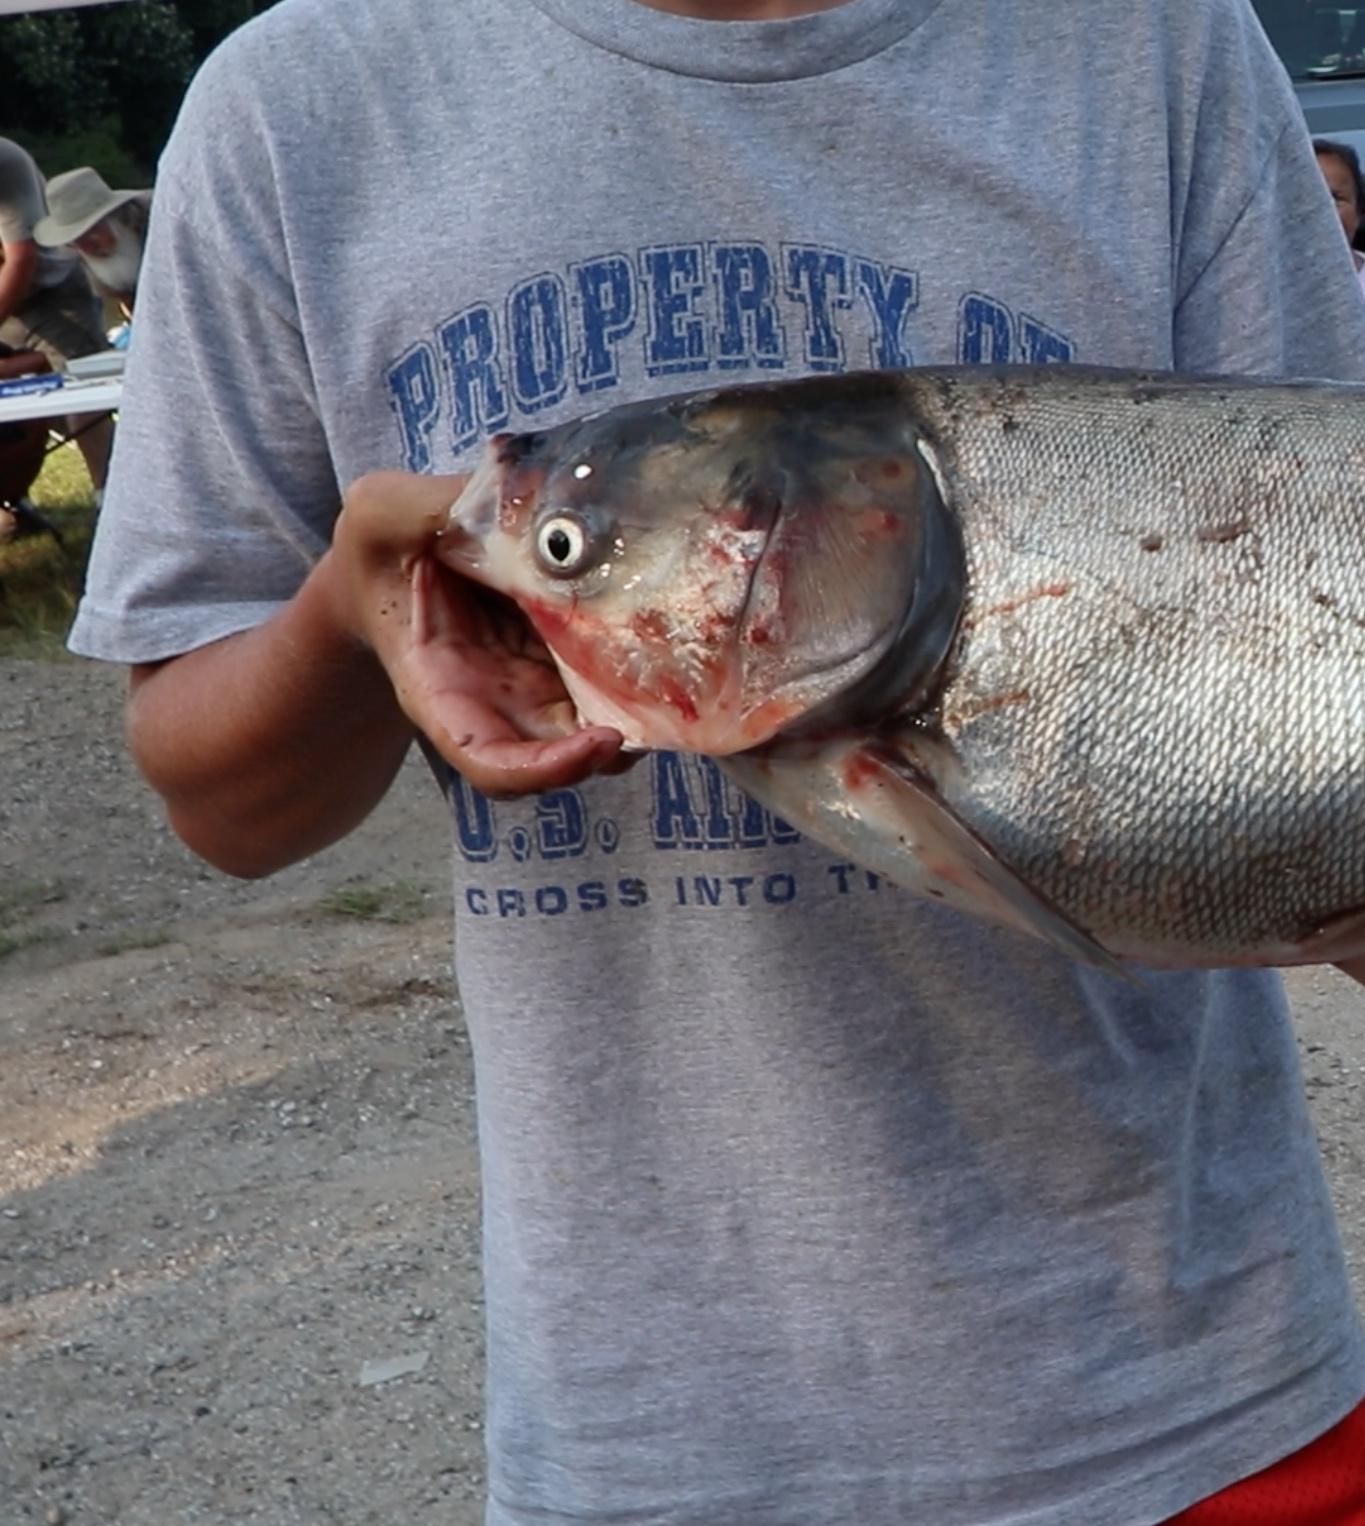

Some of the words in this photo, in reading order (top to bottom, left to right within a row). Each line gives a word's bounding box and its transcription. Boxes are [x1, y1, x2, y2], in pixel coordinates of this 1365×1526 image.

[384, 240, 919, 474] PROPERTY
[466, 877, 648, 917] CROSS
[676, 873, 796, 906] INTO
